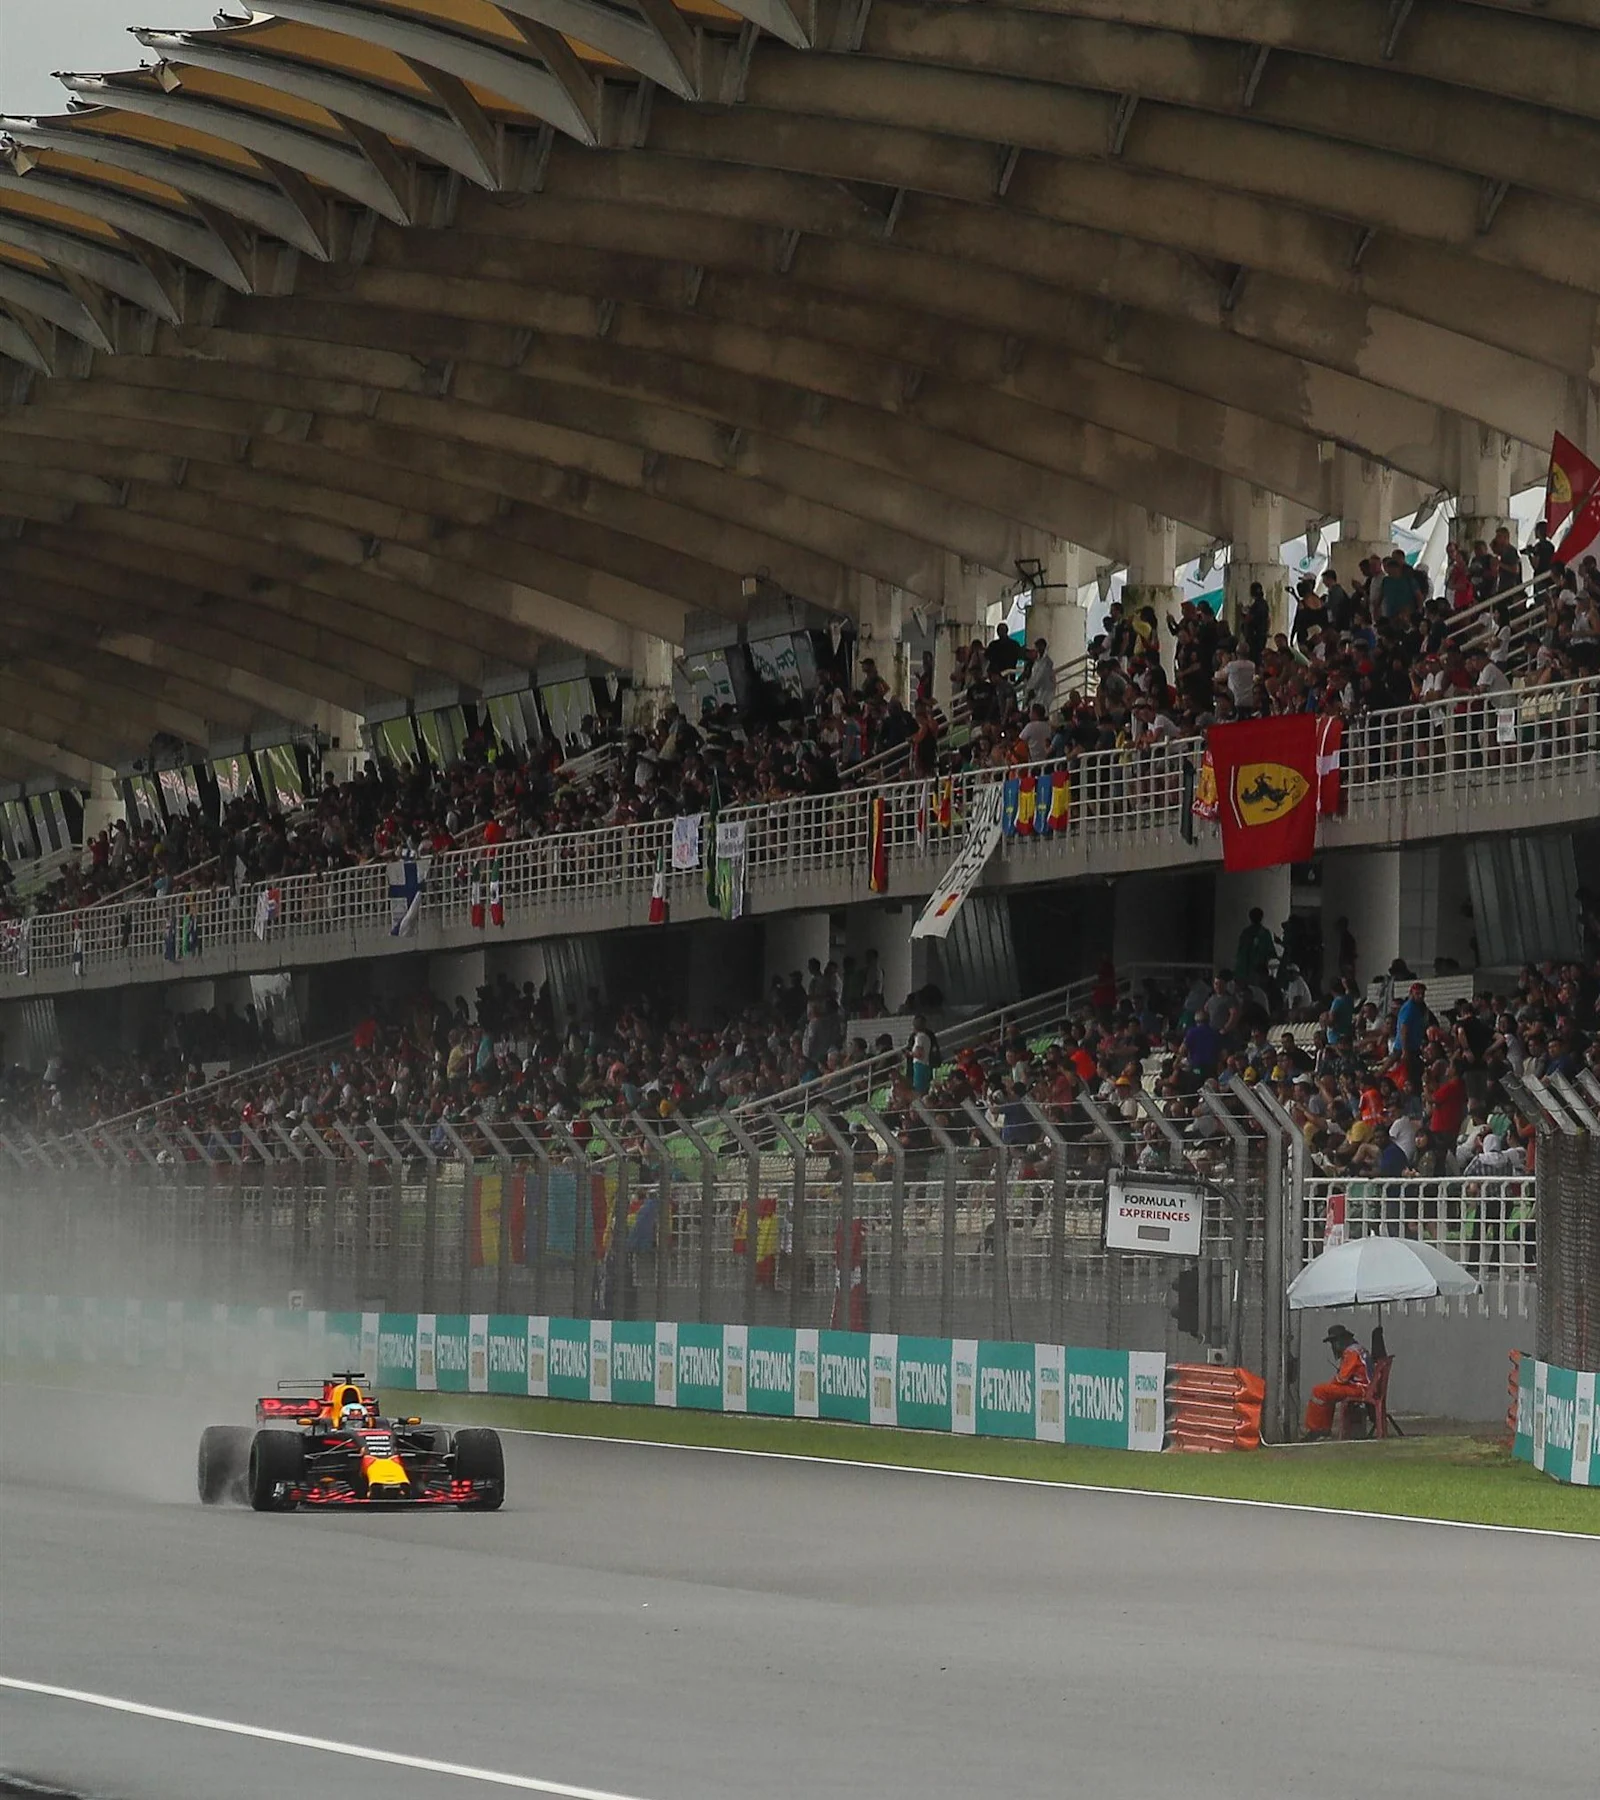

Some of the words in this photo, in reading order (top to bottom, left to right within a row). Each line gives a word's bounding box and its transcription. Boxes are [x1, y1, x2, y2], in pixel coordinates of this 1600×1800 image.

[1119, 1208, 1190, 1222] EXPERIENCES
[1124, 1194, 1177, 1207] FORMULA
[613, 1342, 653, 1382] PETRONAS
[679, 1346, 720, 1387] PETRONAS
[750, 1349, 792, 1393] PETRONAS
[820, 1354, 867, 1399] PETRONAS
[900, 1360, 948, 1406] PETRONAS
[980, 1367, 1032, 1414] PETRONAS
[1068, 1373, 1124, 1422] PETRONAS
